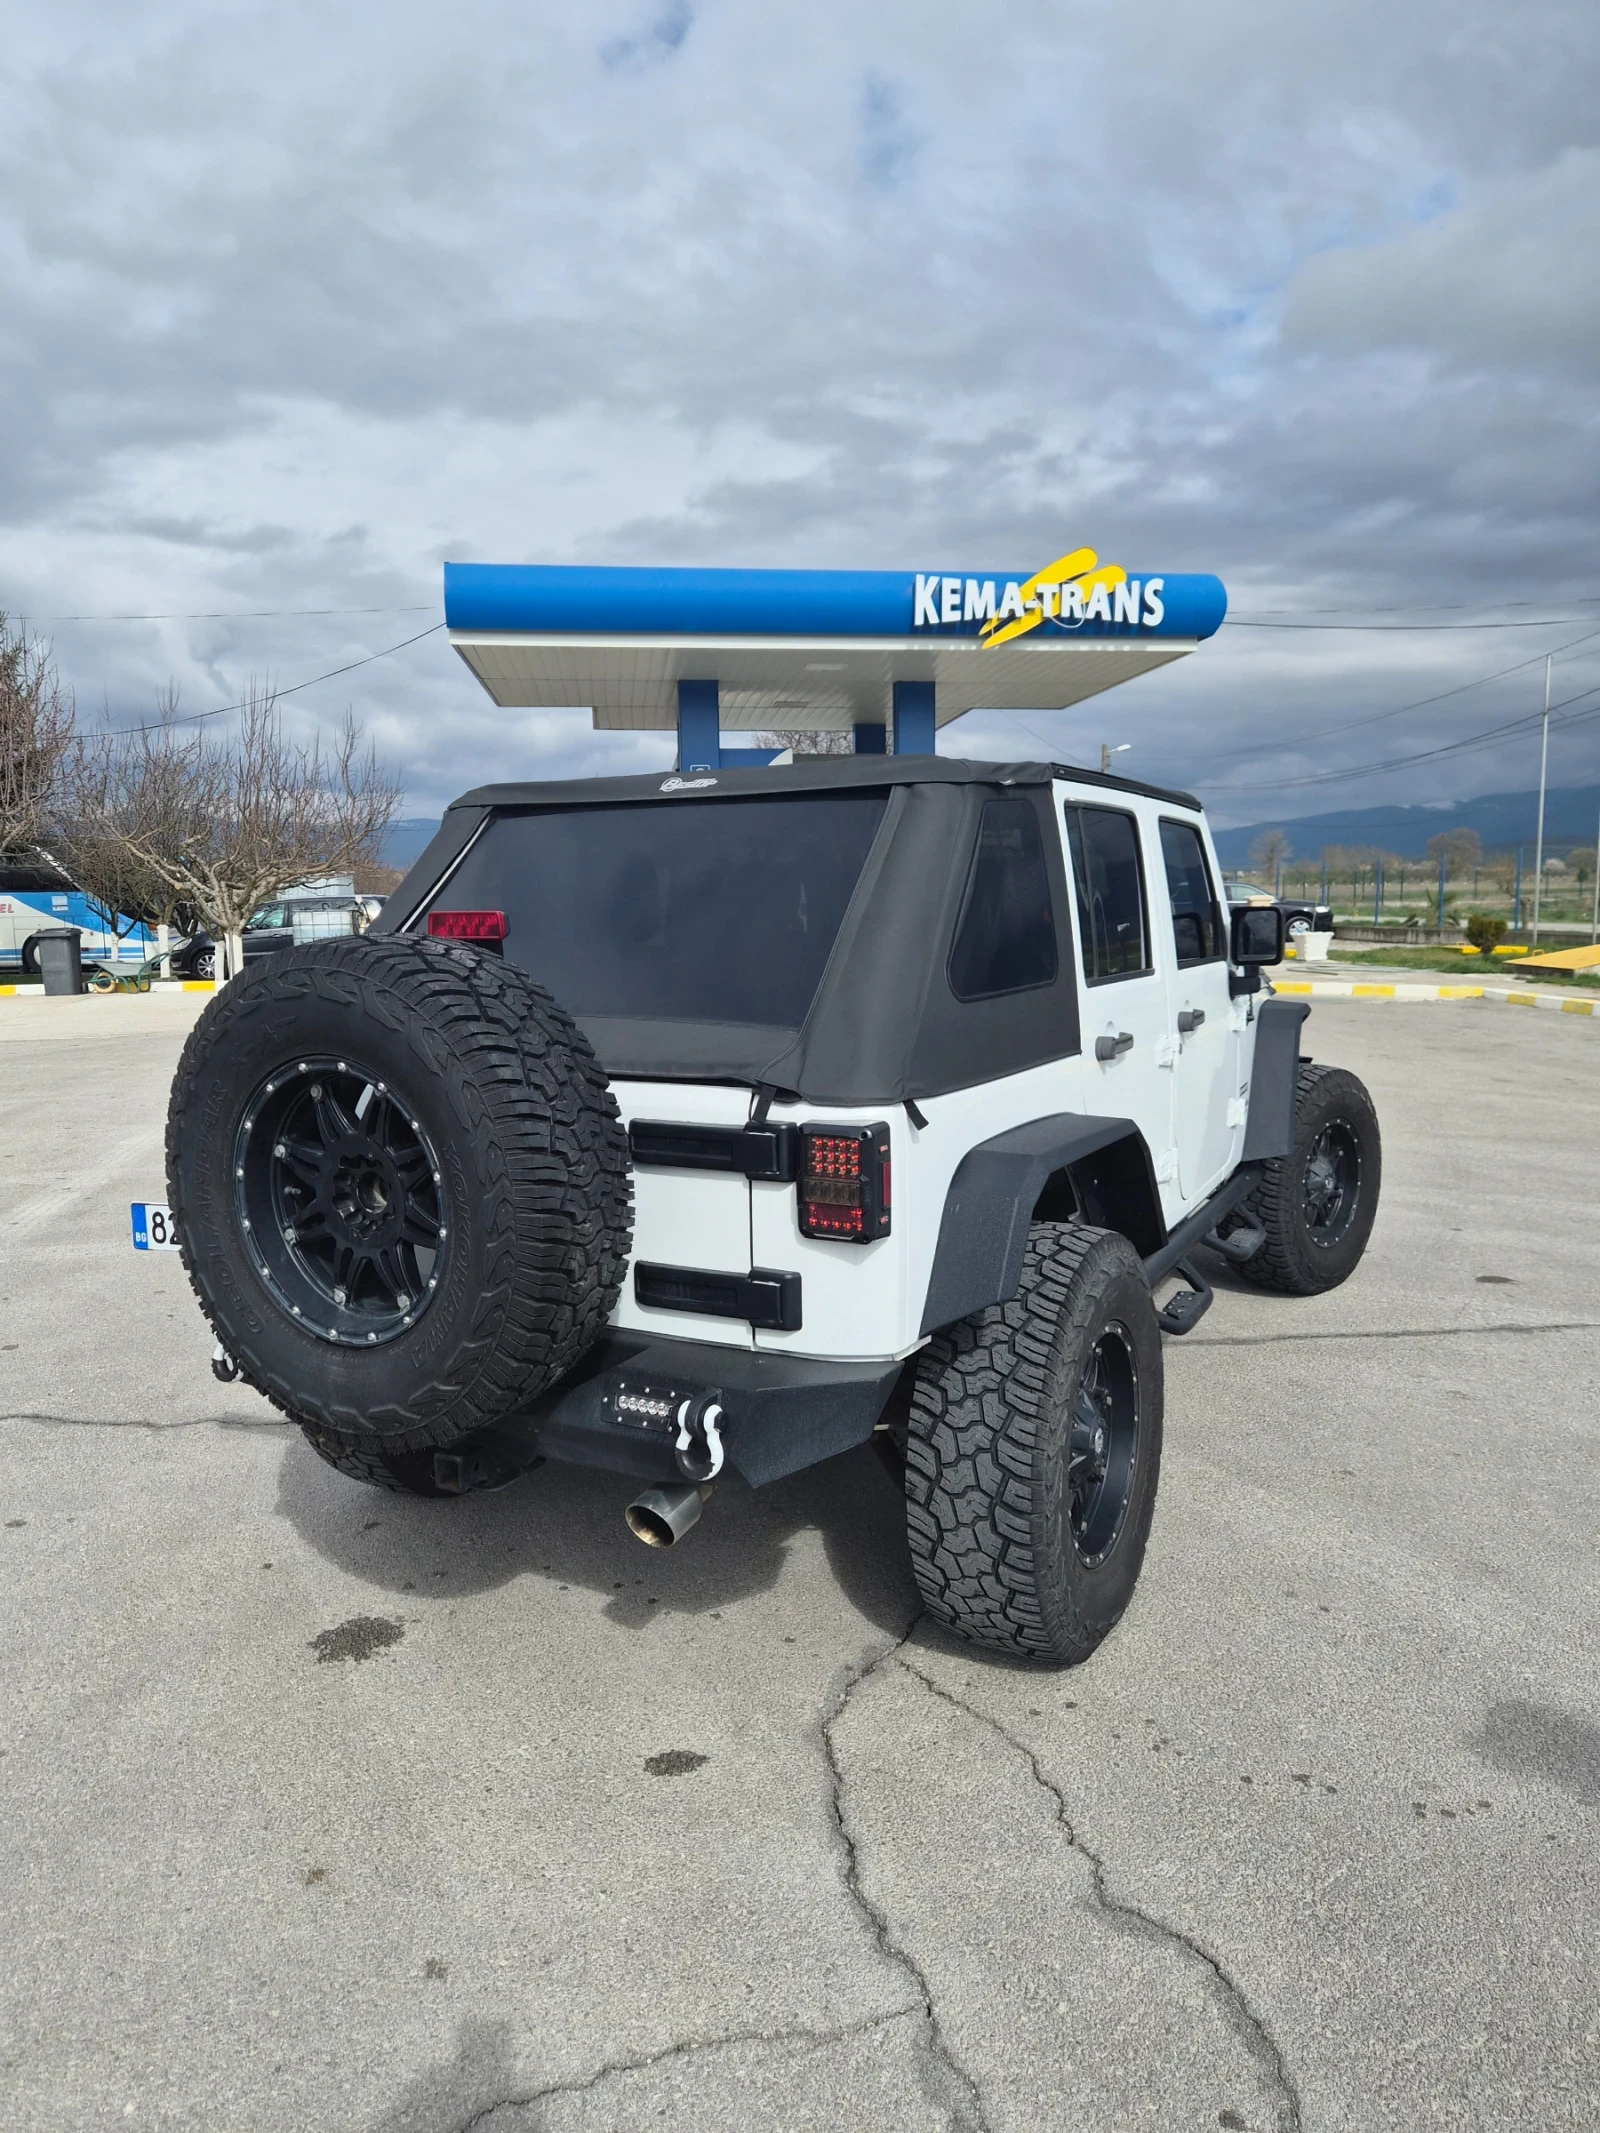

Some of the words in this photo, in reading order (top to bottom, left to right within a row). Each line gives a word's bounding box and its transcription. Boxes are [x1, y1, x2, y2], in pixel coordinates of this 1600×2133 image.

[914, 574, 1165, 627] KEMA-TRANS
[135, 1231, 147, 1243] BG
[411, 1140, 471, 1368] YOKOHAMA
